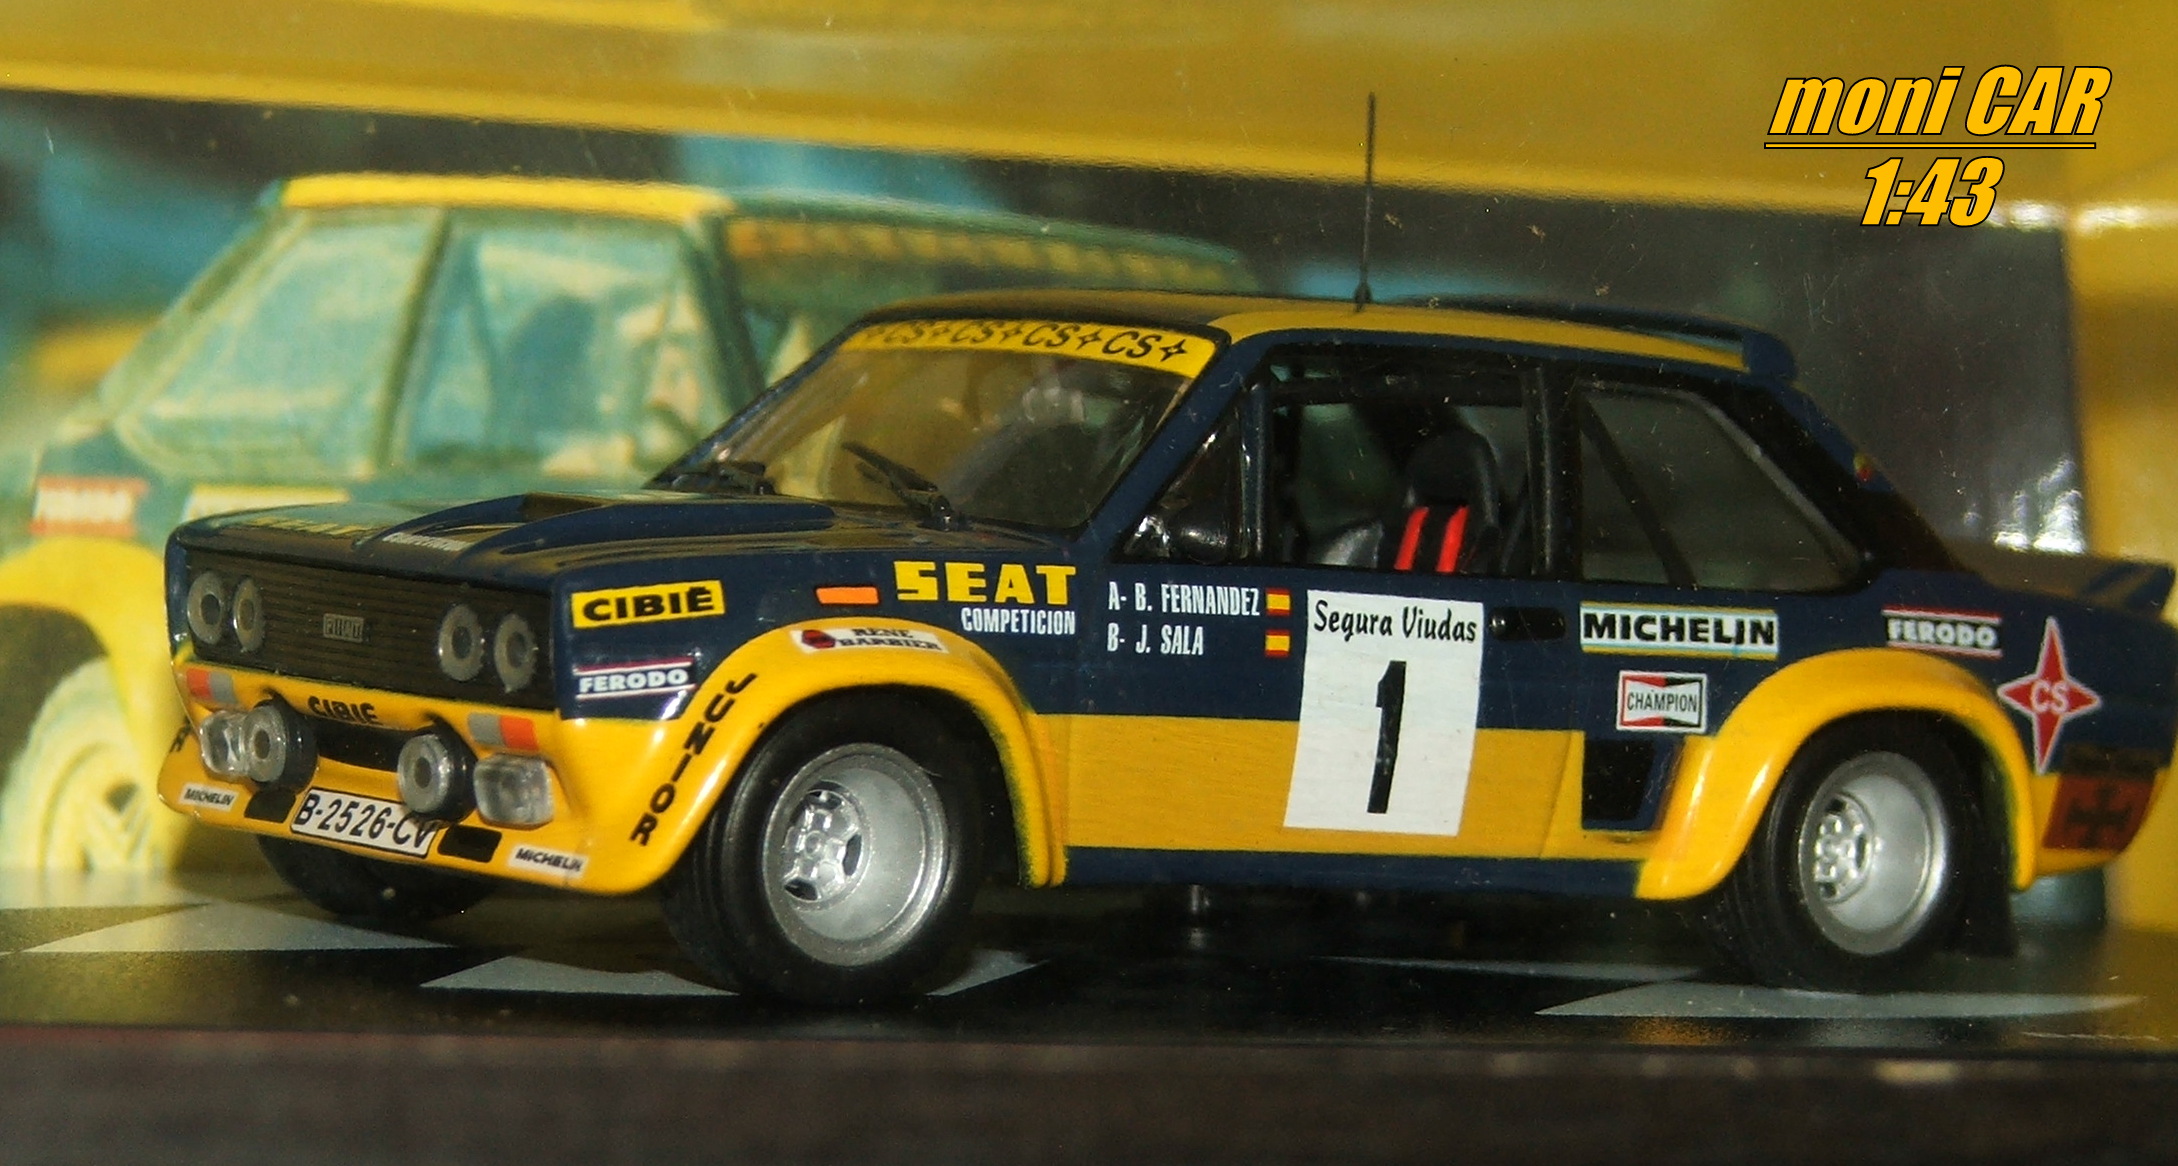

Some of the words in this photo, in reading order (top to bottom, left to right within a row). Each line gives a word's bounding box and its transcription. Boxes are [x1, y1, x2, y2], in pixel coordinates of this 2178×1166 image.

[1022, 324, 1081, 347] CS
[1101, 331, 1162, 359] CS
[894, 561, 1076, 605] SEAT
[1108, 581, 1127, 611] A-
[1134, 582, 1153, 611] B.
[1160, 583, 1260, 616] FERNANDEZ
[961, 607, 1076, 635] COMPETICION
[1314, 599, 1393, 642] Segura
[1402, 606, 1477, 643] Viudas
[1583, 612, 1774, 645] MICHELIN
[1888, 618, 1998, 647] FERODO
[838, 638, 942, 651] BARBIER
[1106, 622, 1126, 652] B-
[1135, 624, 1151, 653] J.
[1160, 624, 1204, 655] SALA
[579, 668, 689, 694] FERODO
[2030, 679, 2070, 715] CS
[1626, 691, 1698, 714] CHAMPION
[1367, 660, 1407, 814] 1
[629, 672, 758, 846] JUNIOR
